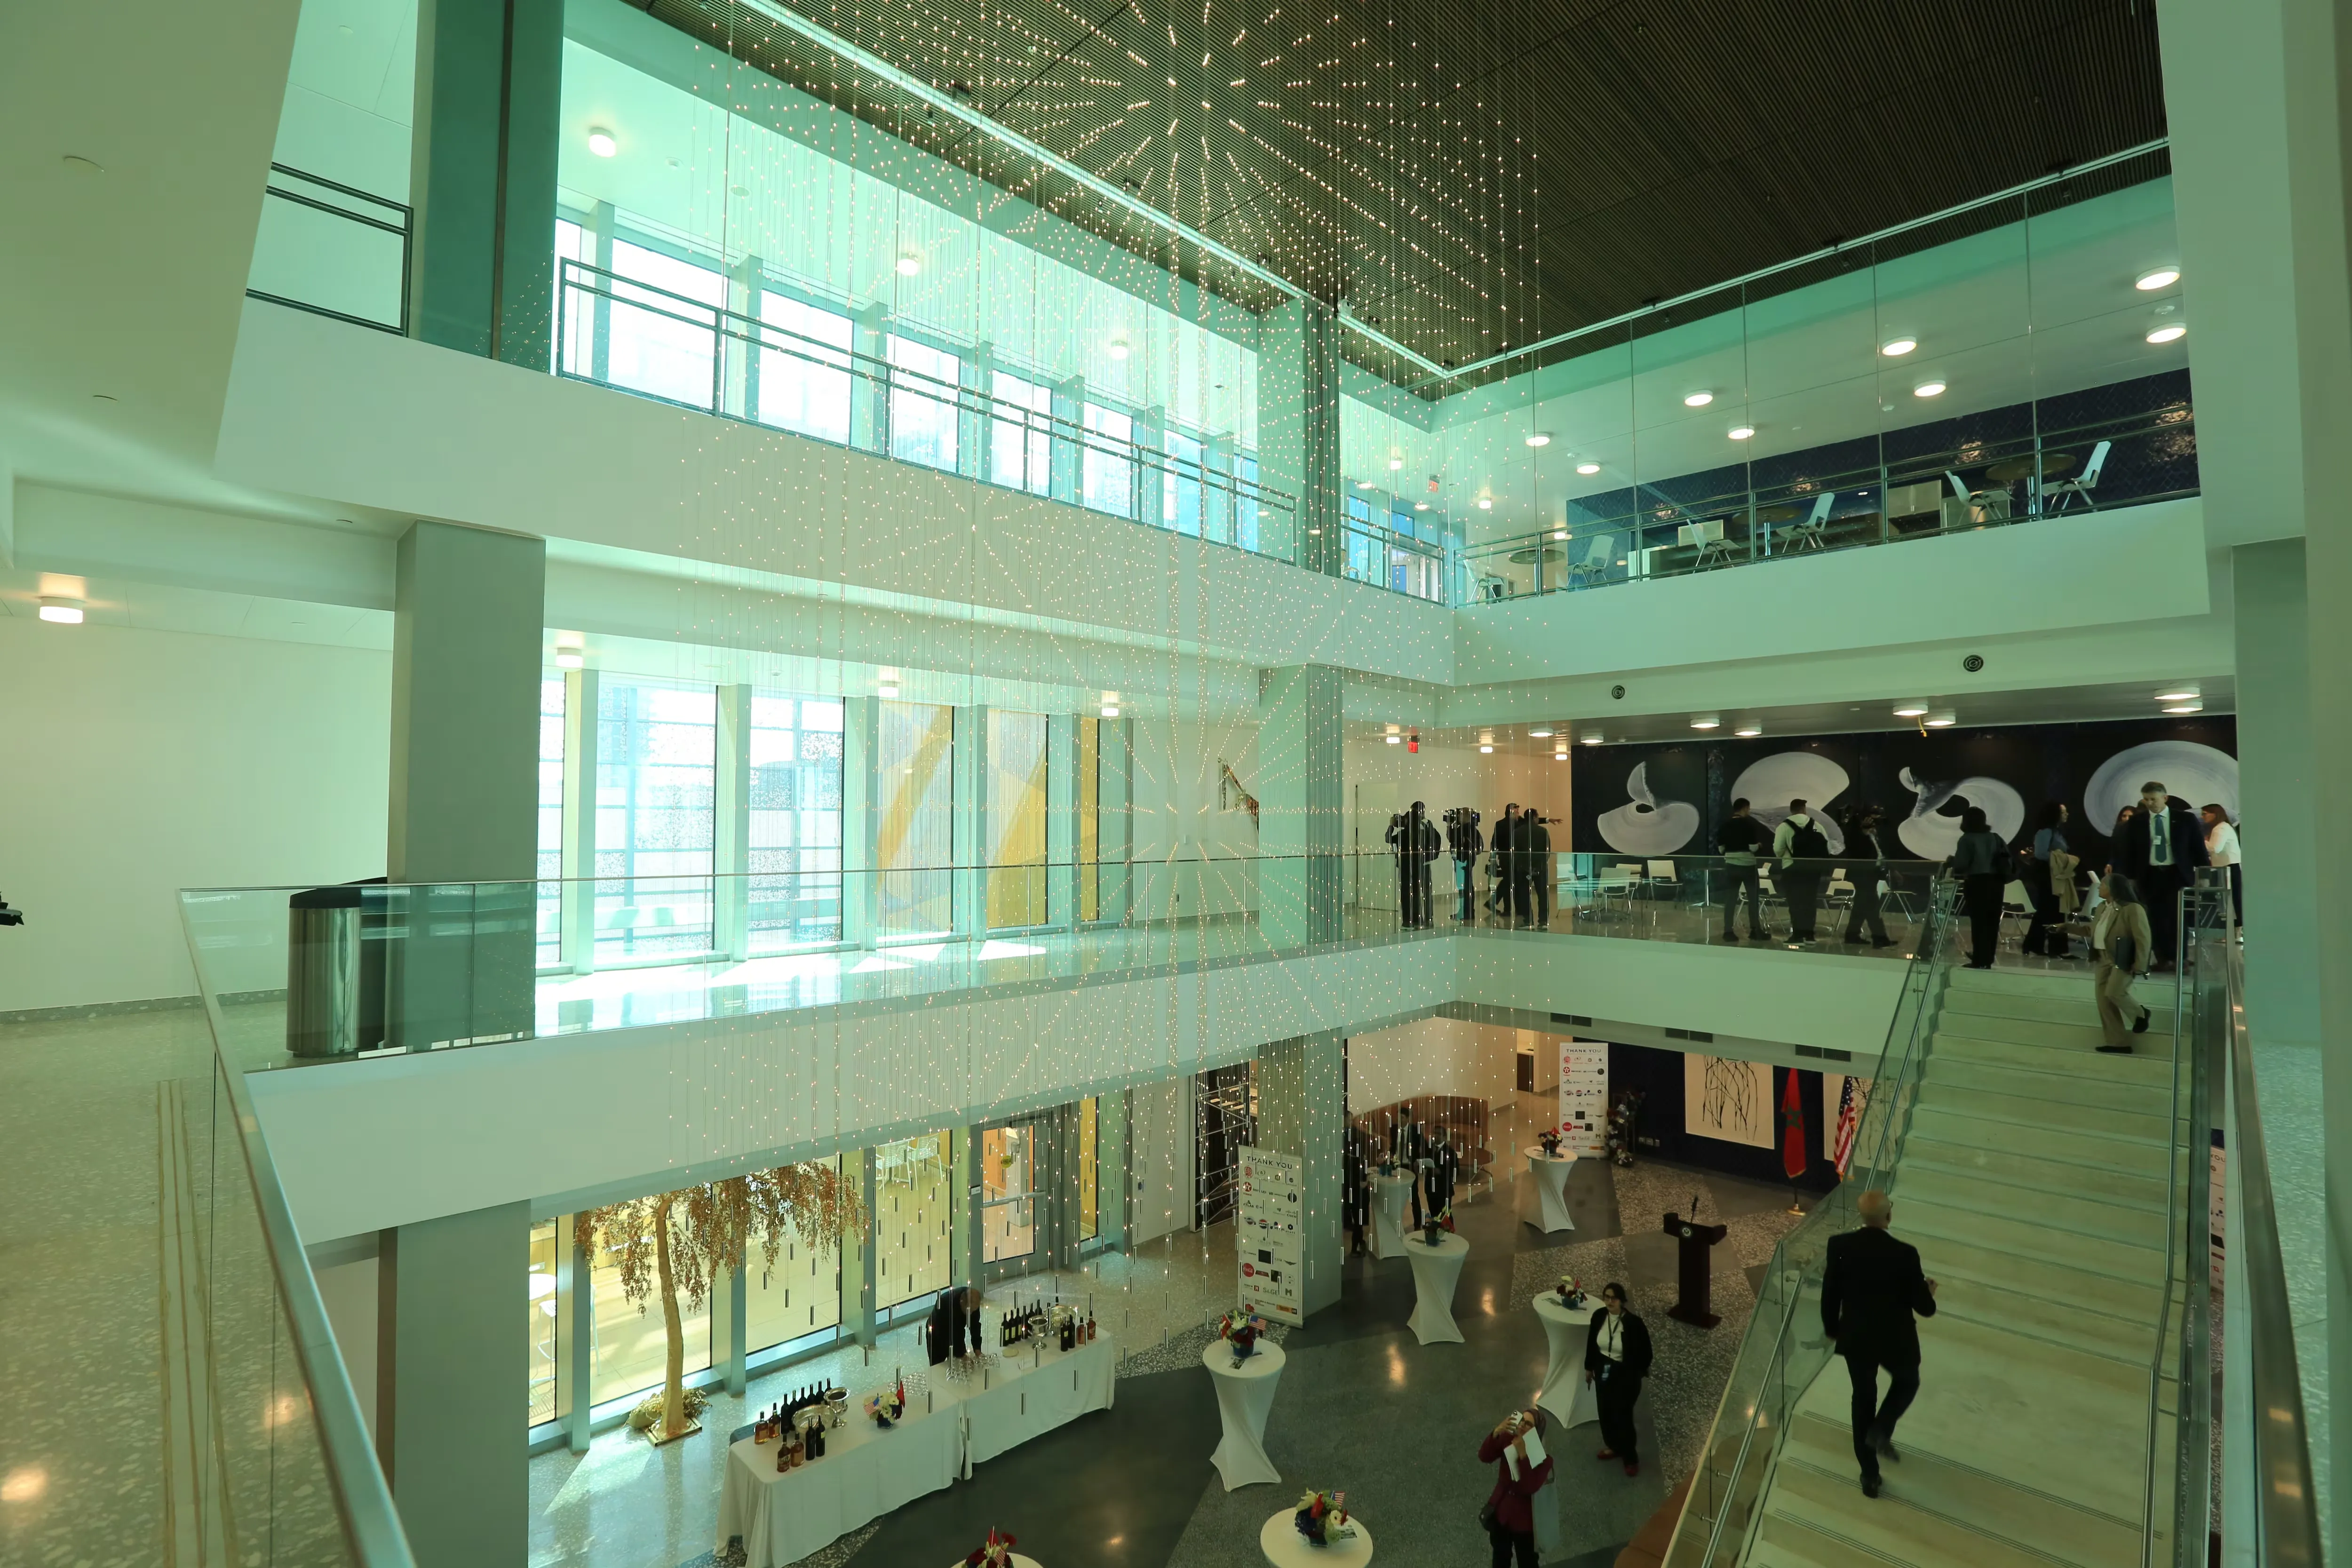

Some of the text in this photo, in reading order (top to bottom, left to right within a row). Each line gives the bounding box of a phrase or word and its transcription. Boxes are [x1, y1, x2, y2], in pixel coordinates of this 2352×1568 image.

[1247, 1156, 1292, 1170] THANK YOU
[1263, 1287, 1278, 1296] SAGE
